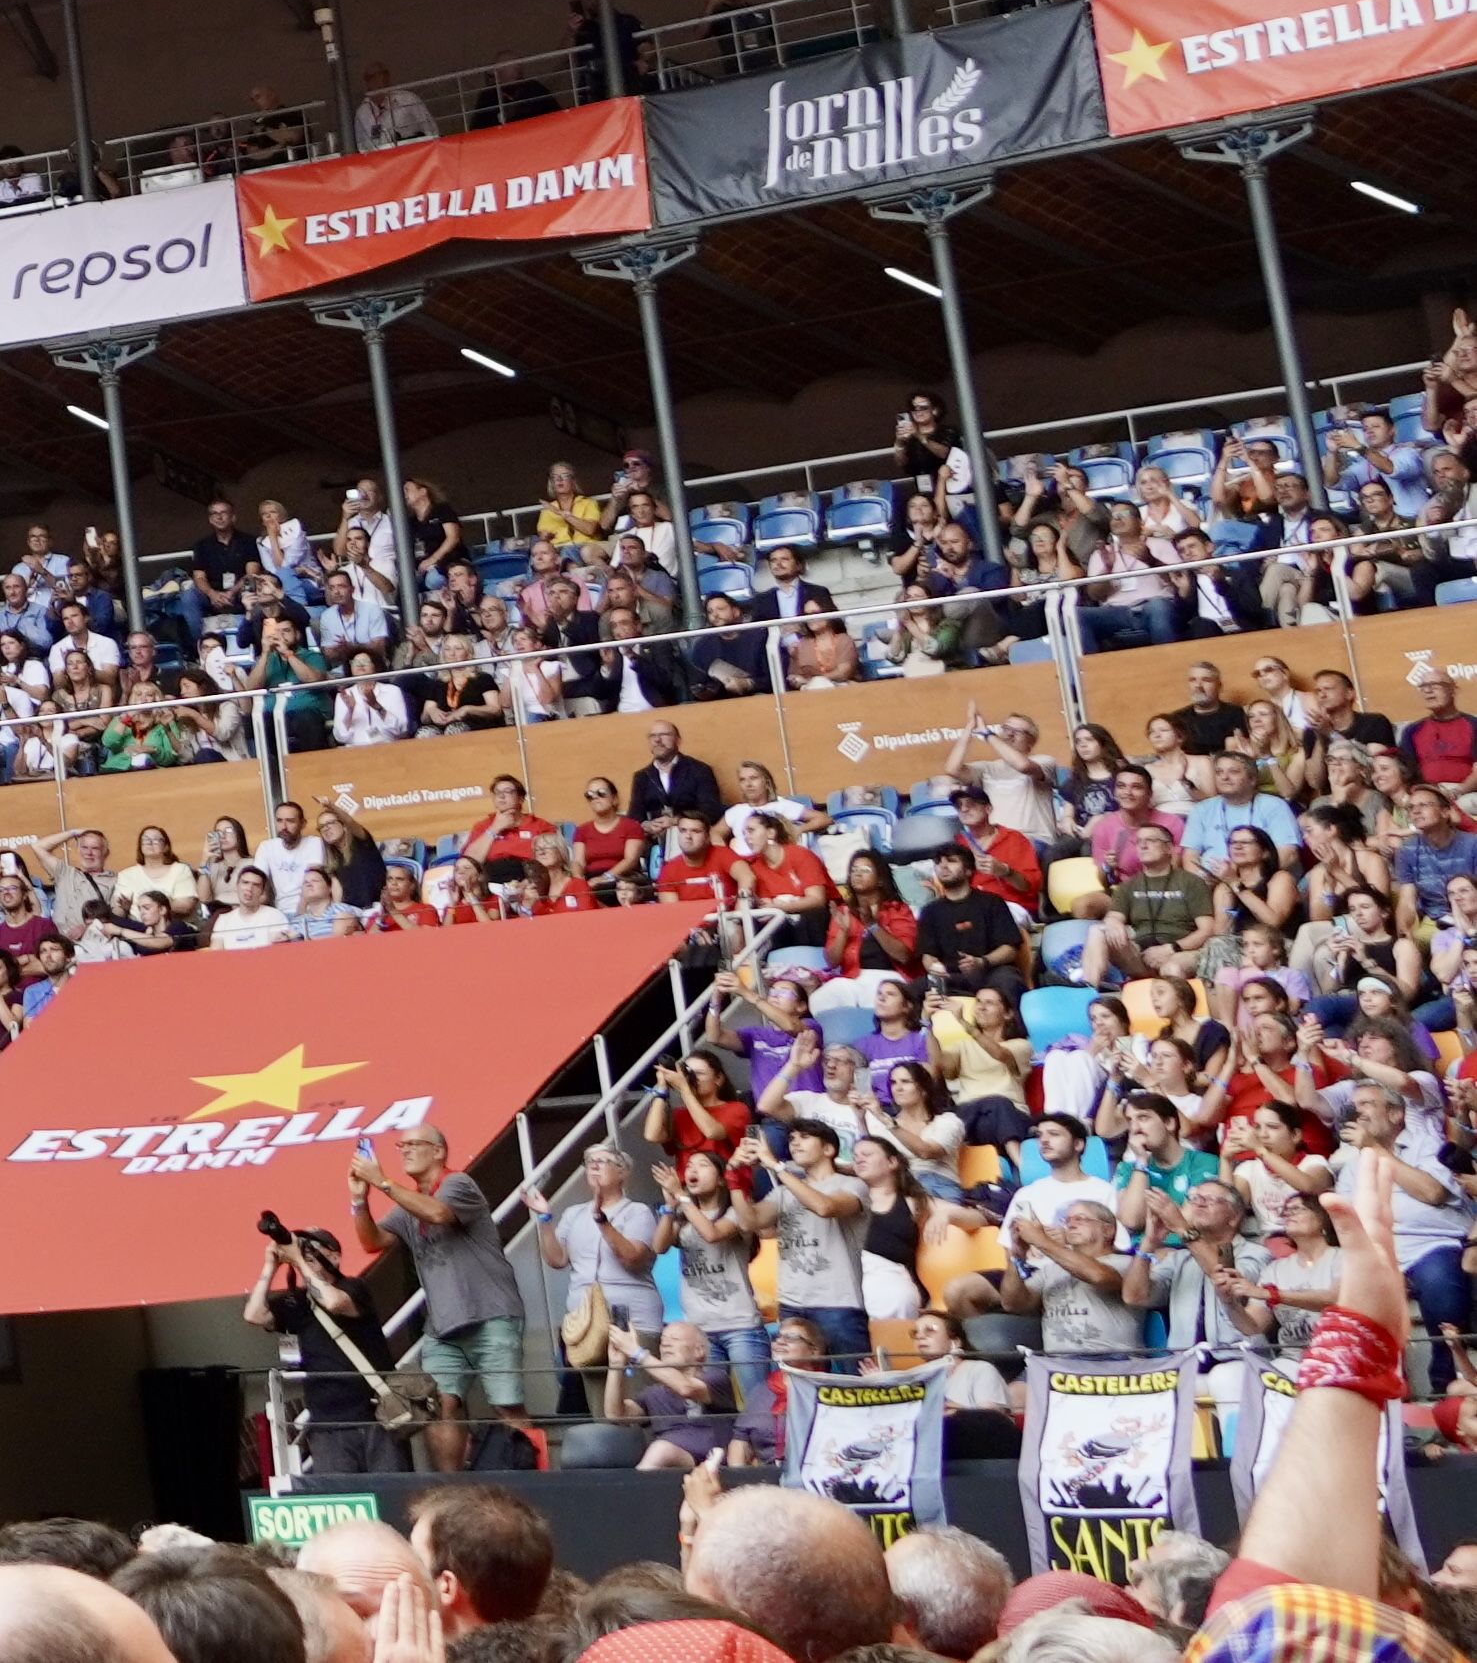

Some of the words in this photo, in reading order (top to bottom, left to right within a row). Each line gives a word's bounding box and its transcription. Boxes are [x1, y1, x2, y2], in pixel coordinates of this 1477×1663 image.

[762, 79, 881, 189] forn
[785, 145, 810, 171] de
[808, 76, 983, 178] nulles
[304, 183, 498, 245] ESTRELLA
[506, 153, 634, 209] DAMM
[12, 223, 213, 300] repsol
[873, 729, 941, 751] Diputació
[363, 793, 420, 810] Diputació
[421, 785, 483, 803] Tarragona
[6, 1096, 433, 1162] ESTRELLA
[120, 1146, 277, 1175] DAMM
[1051, 1370, 1178, 1395] CASTELLERS
